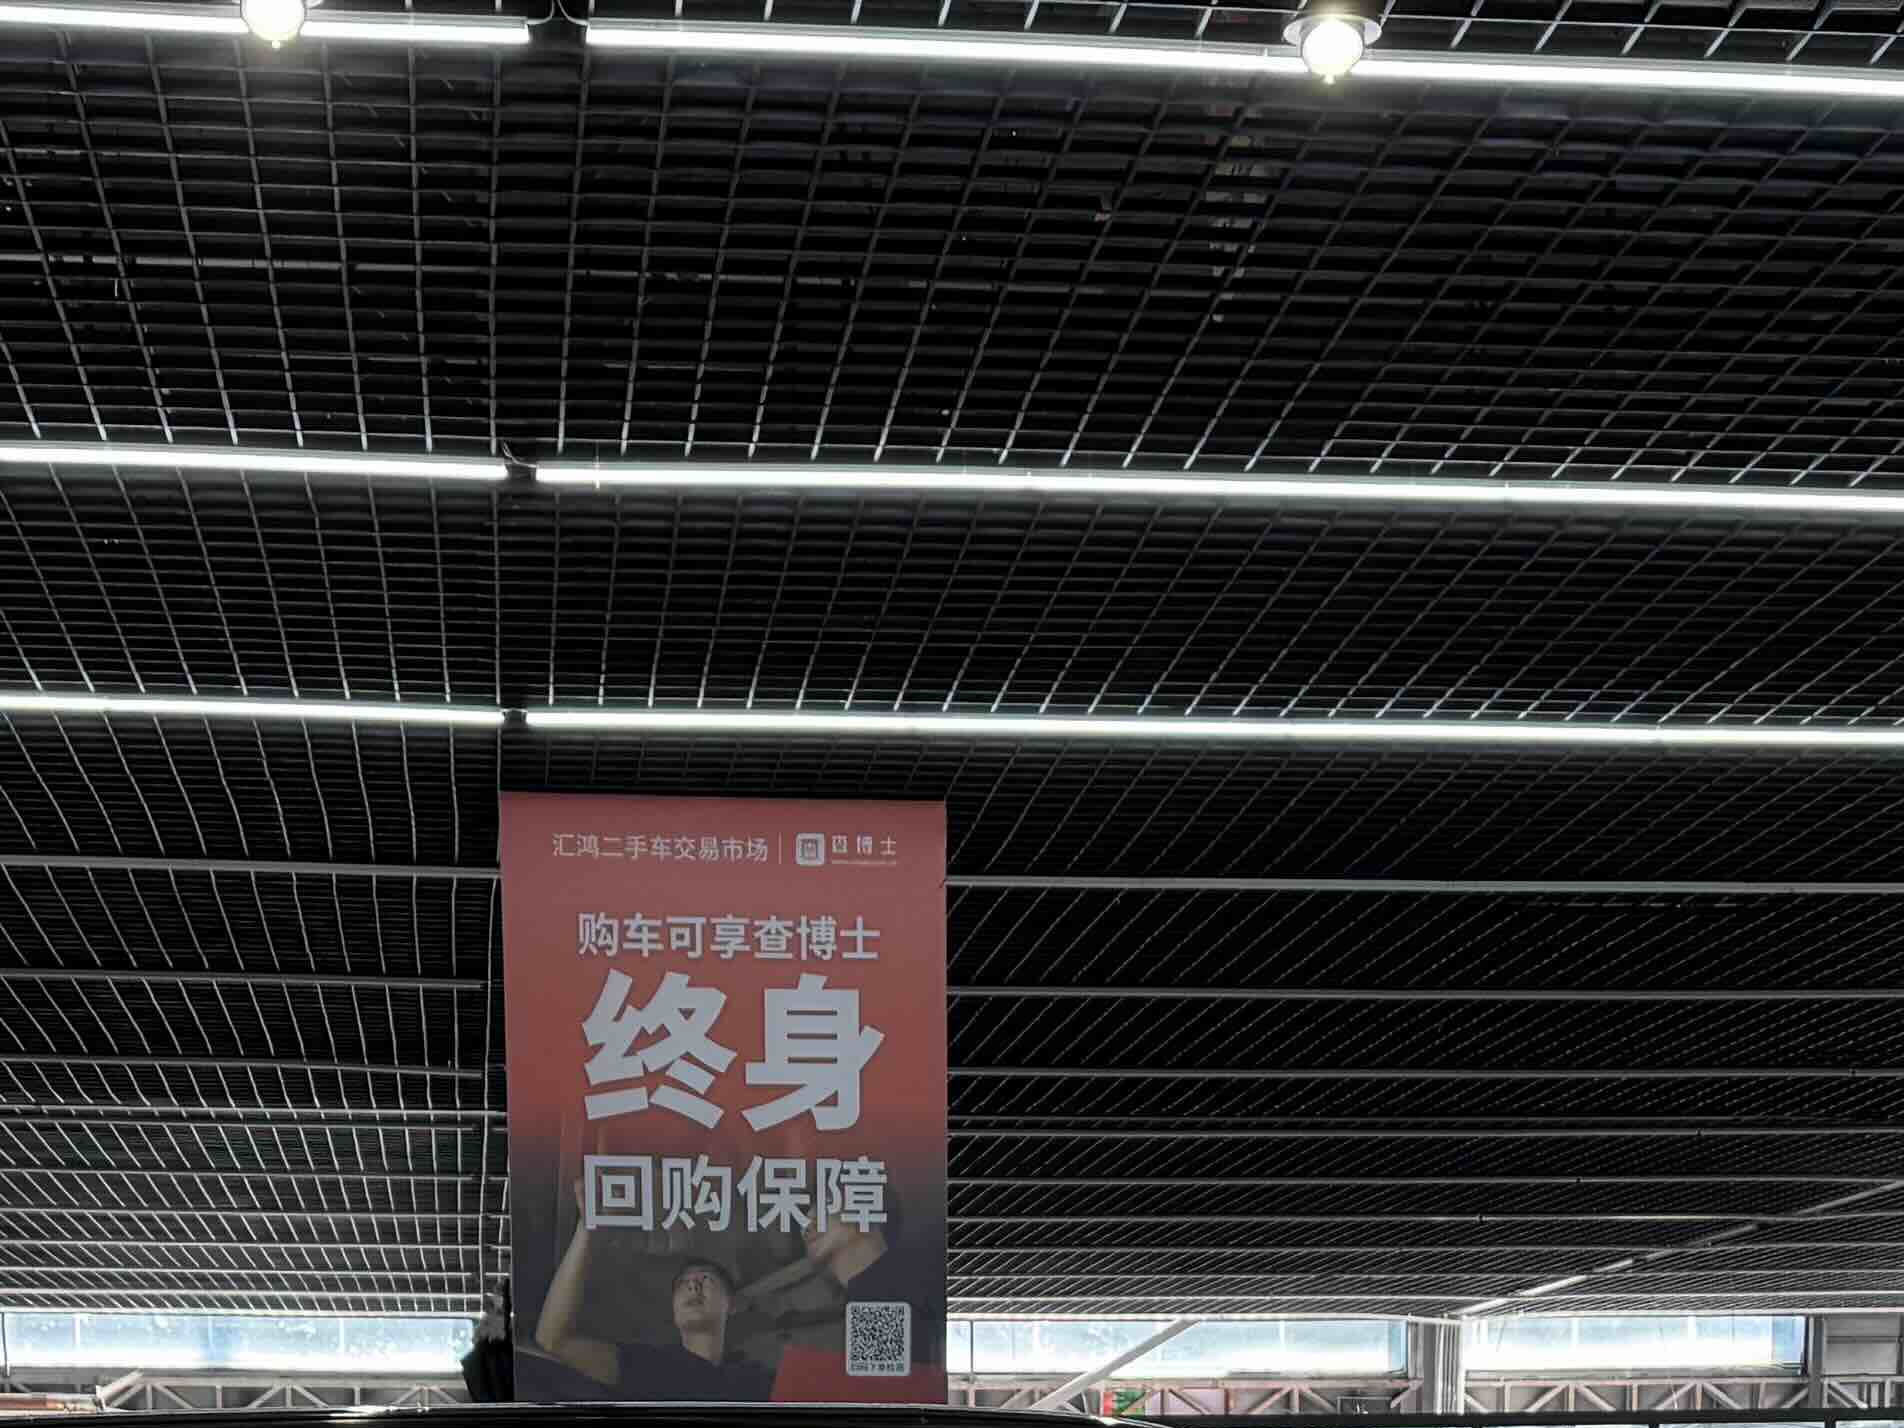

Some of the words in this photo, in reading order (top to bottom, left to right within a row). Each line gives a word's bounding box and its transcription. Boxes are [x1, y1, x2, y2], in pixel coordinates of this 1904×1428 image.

[552, 832, 769, 863] 汇鸿二手车交易市场
[576, 912, 881, 961] 购车可享查博士
[581, 967, 886, 1133] 终身
[582, 1154, 889, 1234] 回购保障
